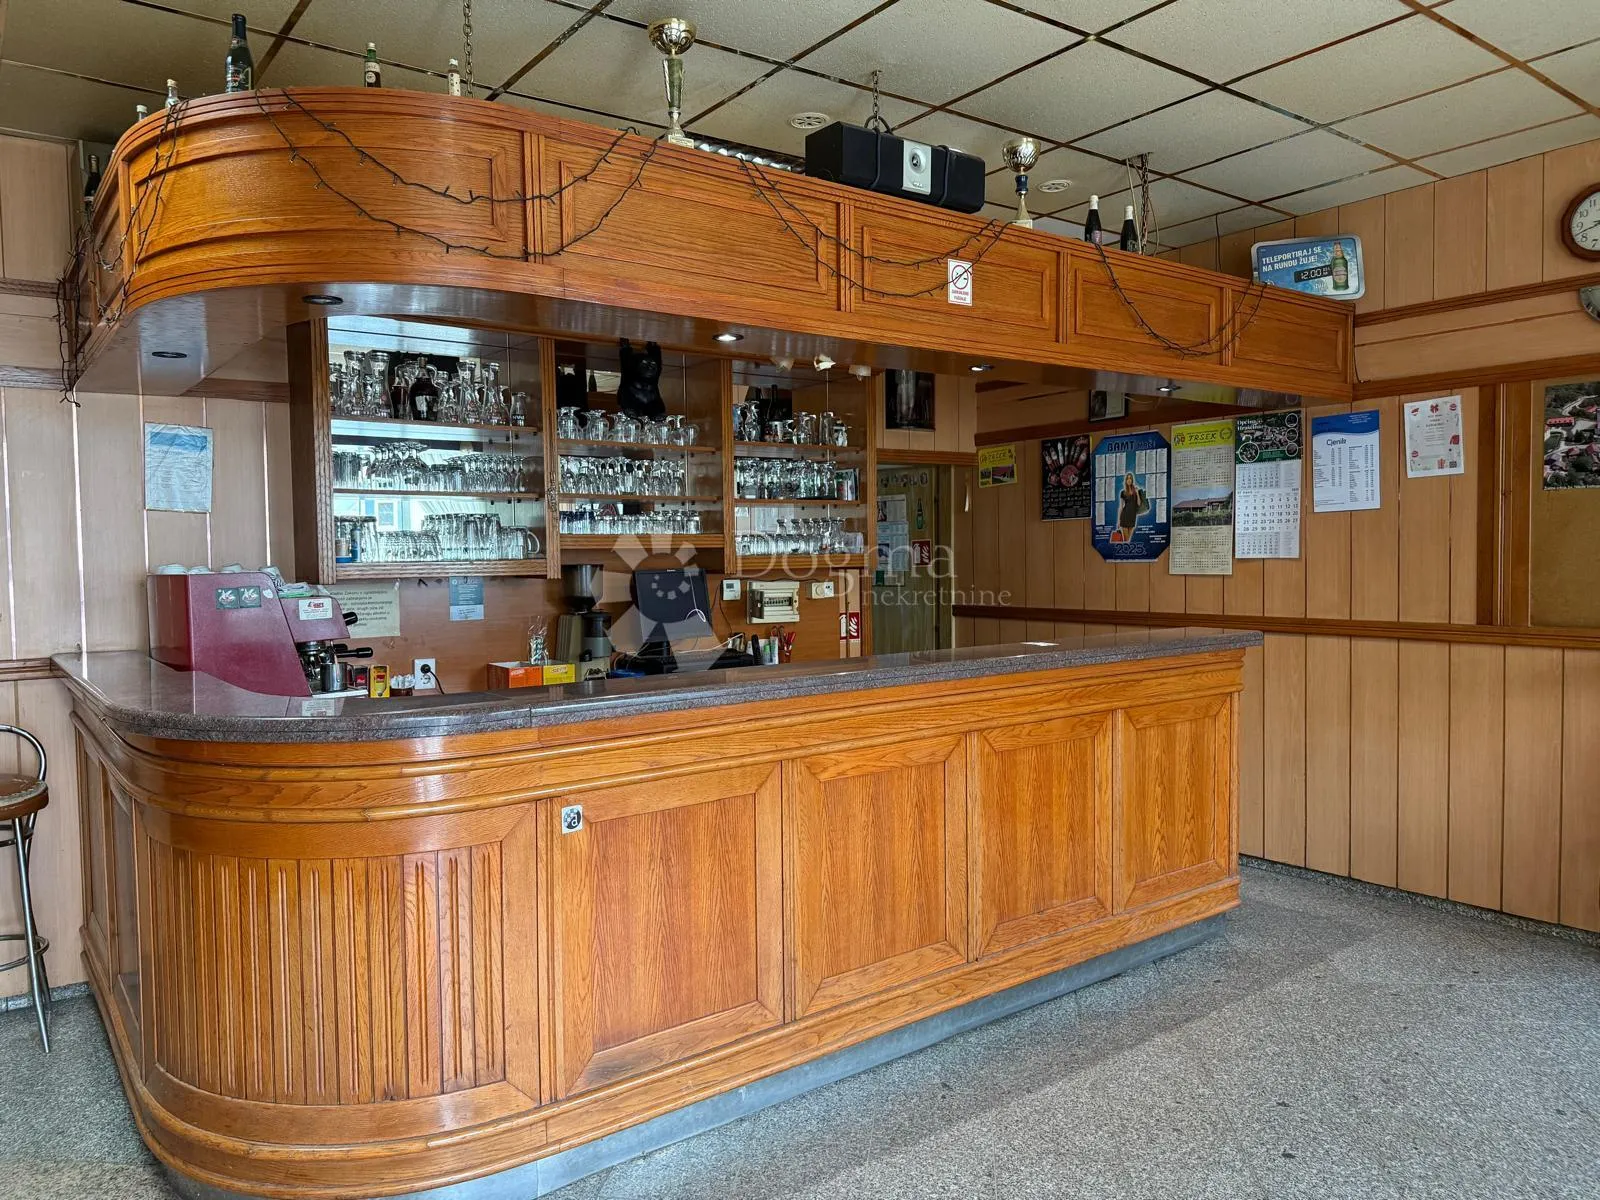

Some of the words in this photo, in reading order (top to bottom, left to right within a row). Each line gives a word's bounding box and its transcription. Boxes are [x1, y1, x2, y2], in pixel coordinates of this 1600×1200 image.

[1589, 199, 1596, 208] 11
[1579, 209, 1589, 218] 10
[1576, 221, 1584, 231] 9
[1580, 232, 1588, 243] 8
[1591, 238, 1599, 248] 7
[1261, 248, 1312, 265] TELEPORTIRAJ
[1313, 246, 1322, 254] SE
[1262, 264, 1273, 273] NA
[1274, 260, 1298, 270] RUNDU
[1299, 256, 1318, 266] ŽUJE!
[1107, 440, 1135, 453] BAMT
[1326, 437, 1347, 447] Cjenik
[1115, 542, 1147, 556] 2025.
